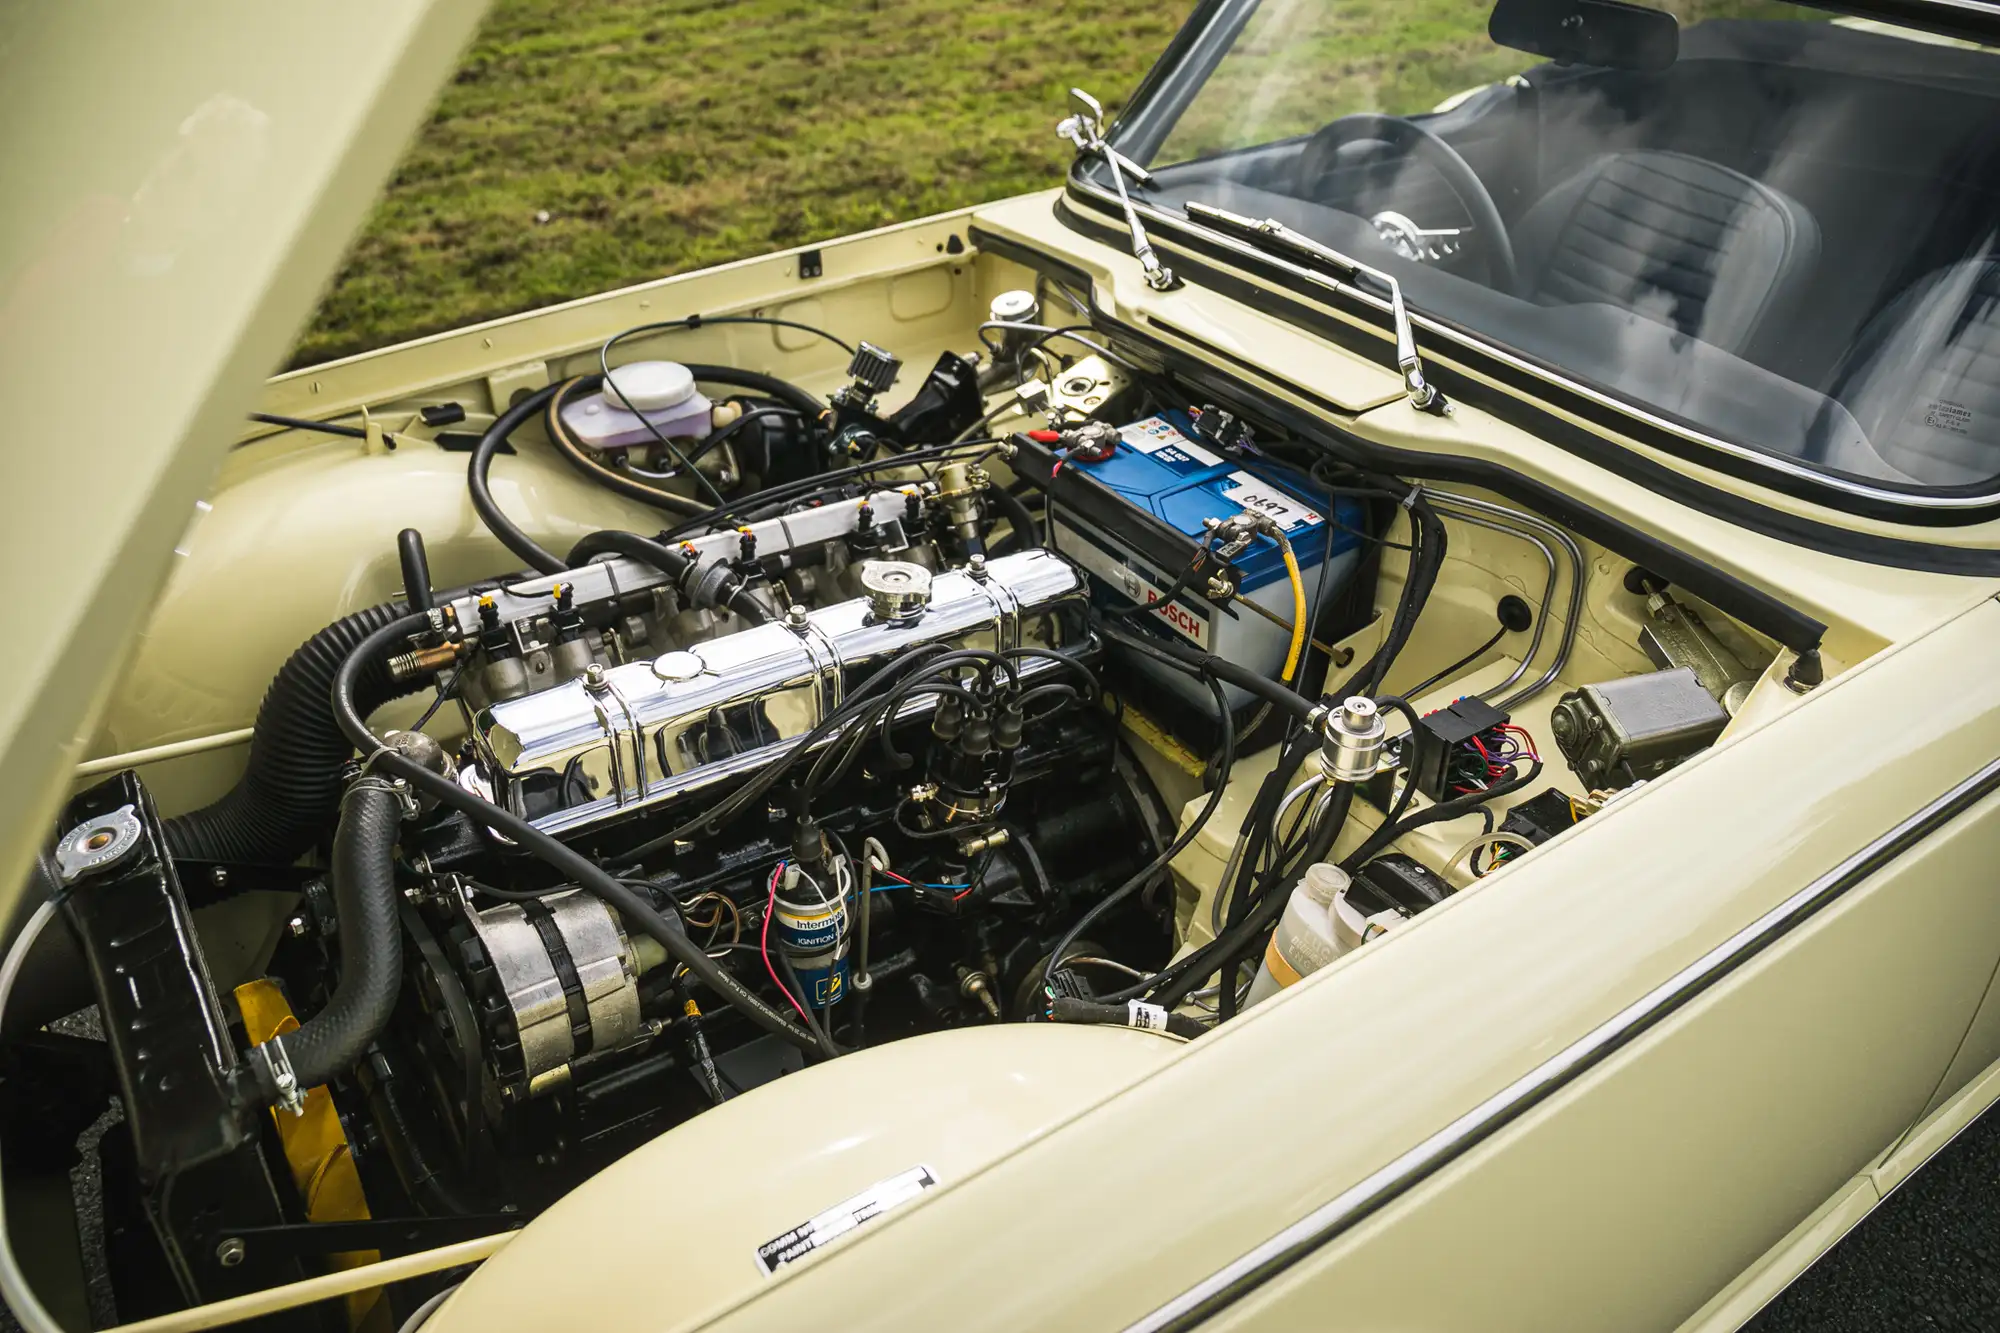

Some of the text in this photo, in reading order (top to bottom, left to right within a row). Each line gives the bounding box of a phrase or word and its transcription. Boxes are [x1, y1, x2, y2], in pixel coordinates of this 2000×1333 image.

[1243, 495, 1289, 516] 0697
[798, 933, 834, 945] IGNITION
[777, 1236, 813, 1262] PAINT
